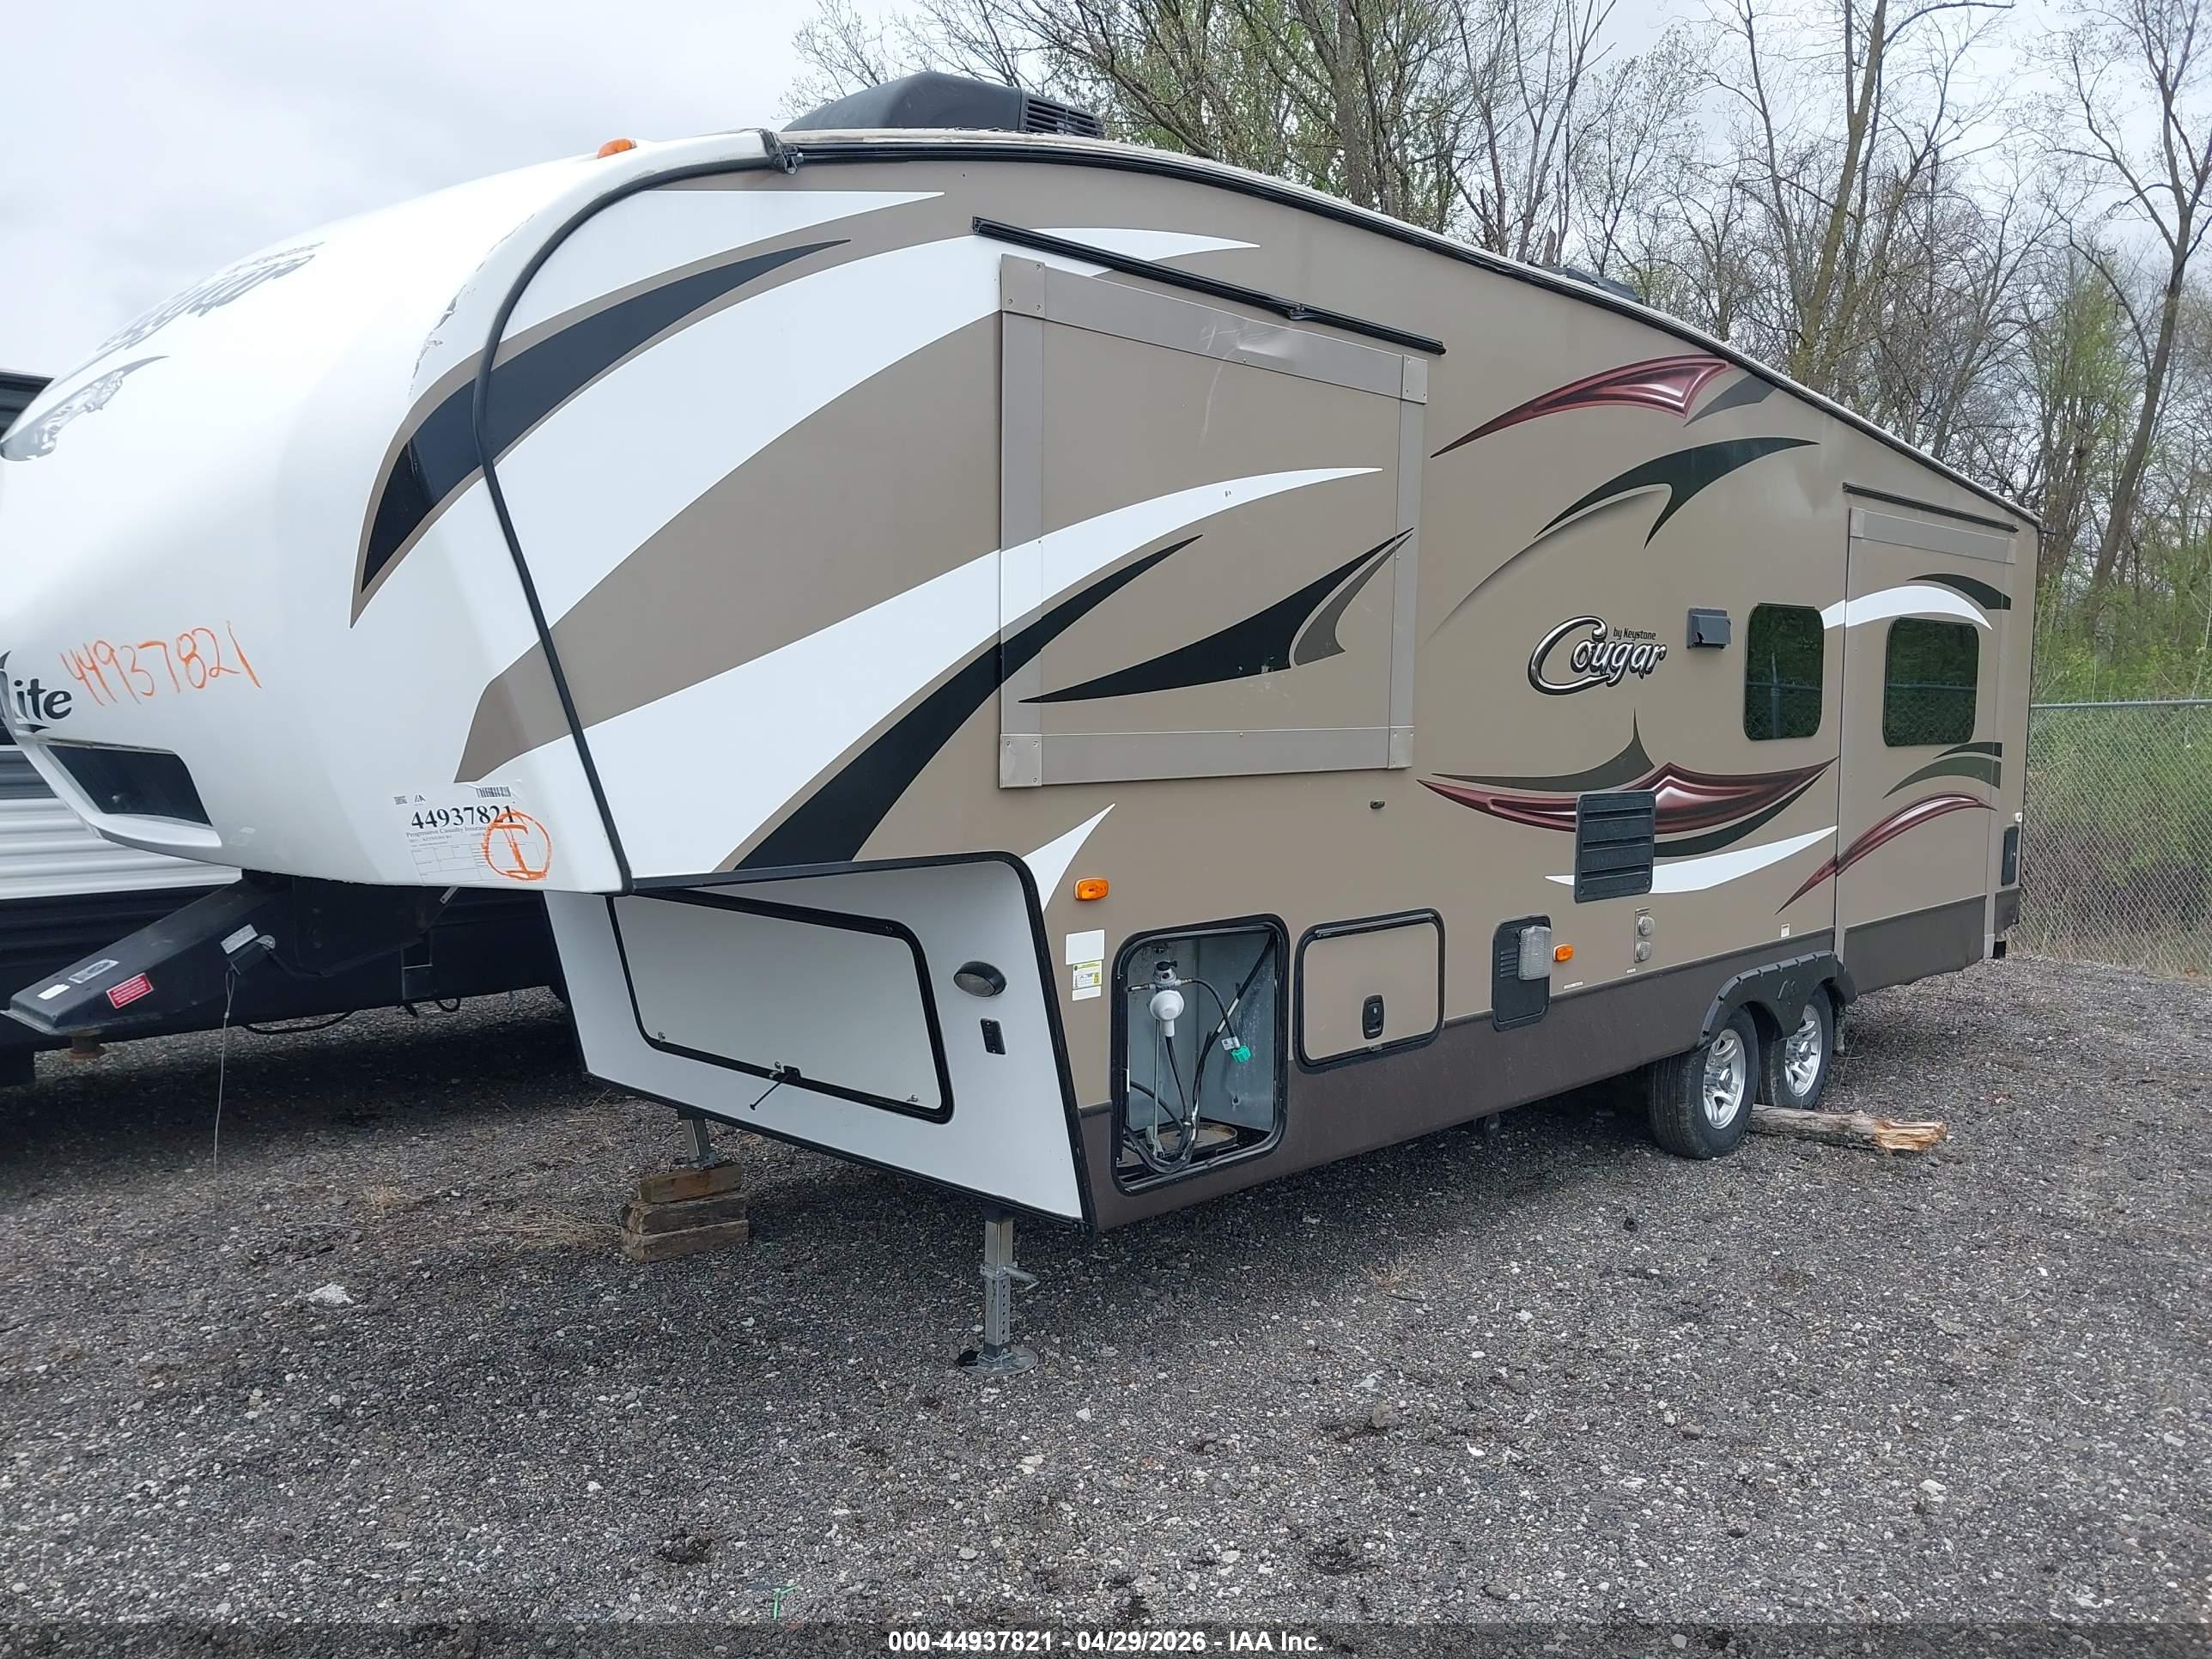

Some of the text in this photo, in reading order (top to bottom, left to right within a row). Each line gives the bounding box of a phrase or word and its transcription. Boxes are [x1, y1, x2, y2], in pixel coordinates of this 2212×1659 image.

[1528, 615, 1668, 696] Cougar
[1613, 627, 1656, 641] by Keystone
[59, 620, 262, 707] 44937821
[411, 805, 515, 830] 44937821
